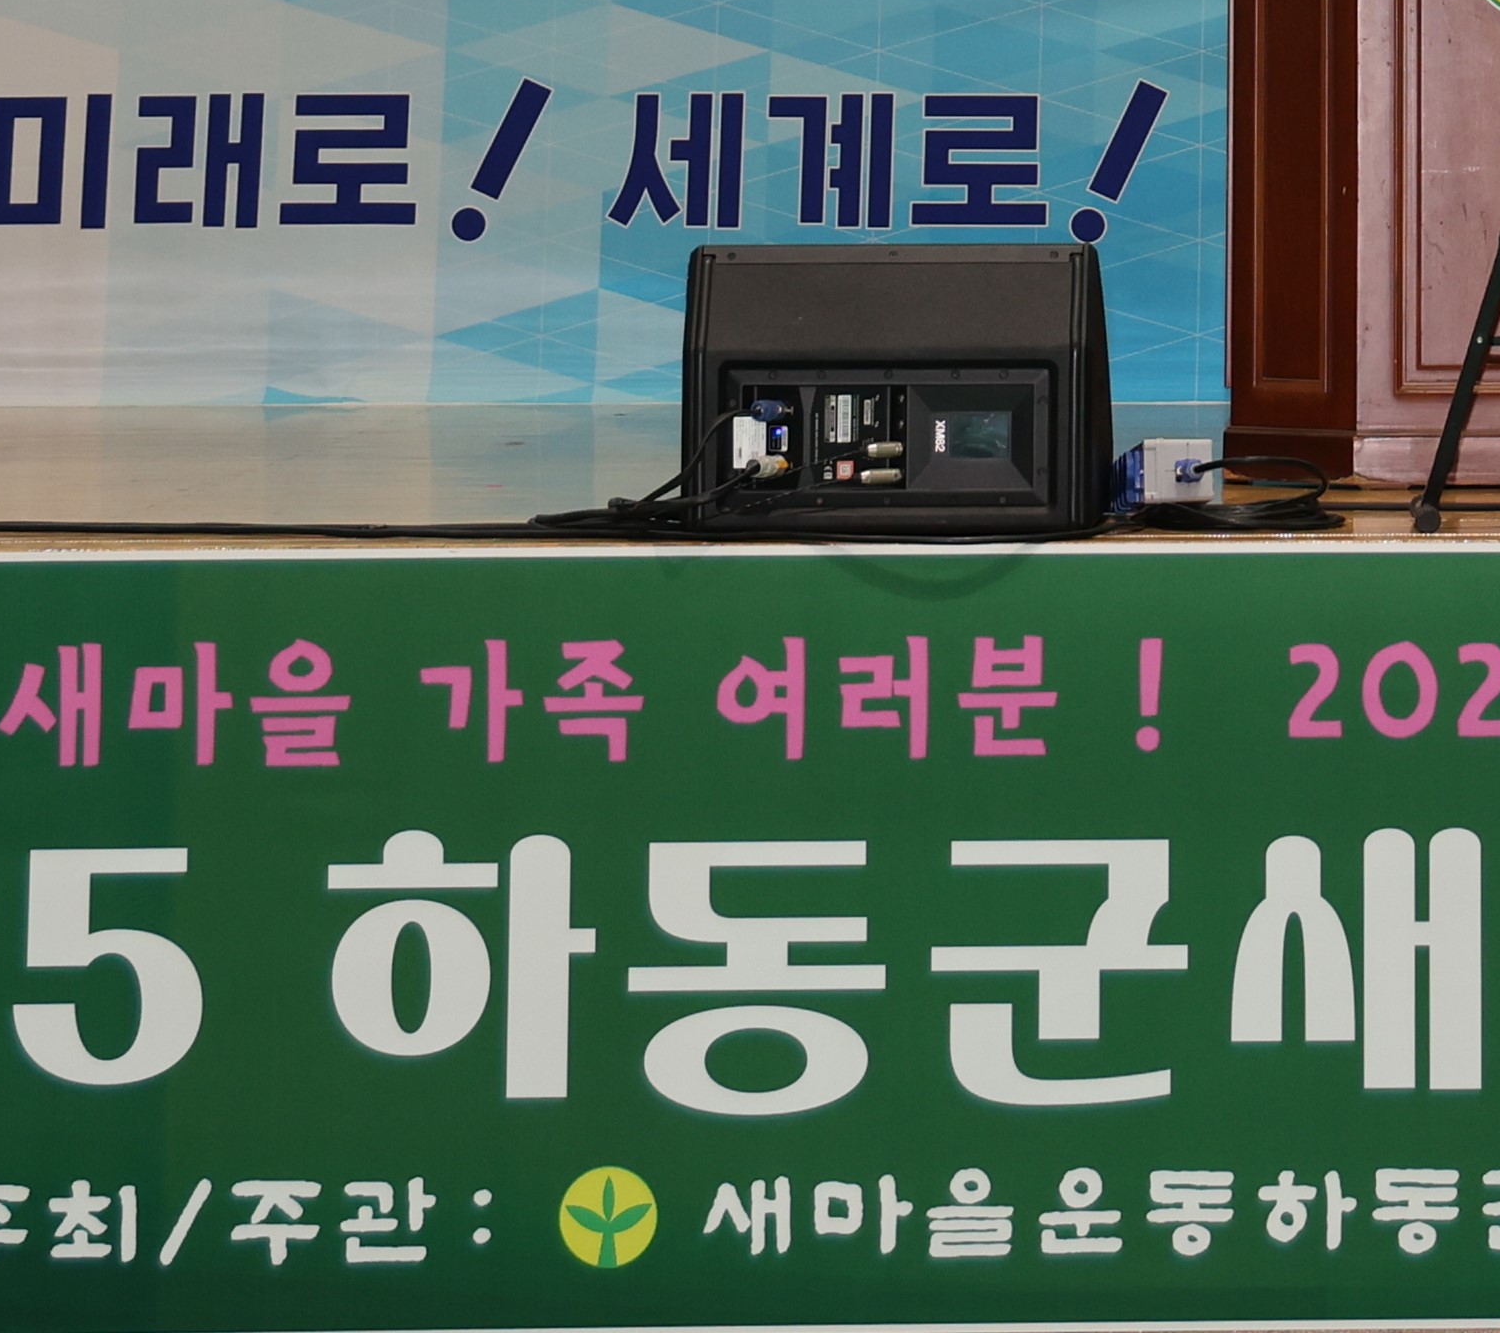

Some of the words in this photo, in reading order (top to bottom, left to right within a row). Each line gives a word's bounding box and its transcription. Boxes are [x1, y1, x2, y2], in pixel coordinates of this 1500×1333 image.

[607, 78, 1169, 245] 세계로!
[934, 419, 947, 453] XM82
[0, 639, 351, 767] 새마을
[420, 640, 644, 762] 가족
[717, 635, 1058, 760] 여러분
